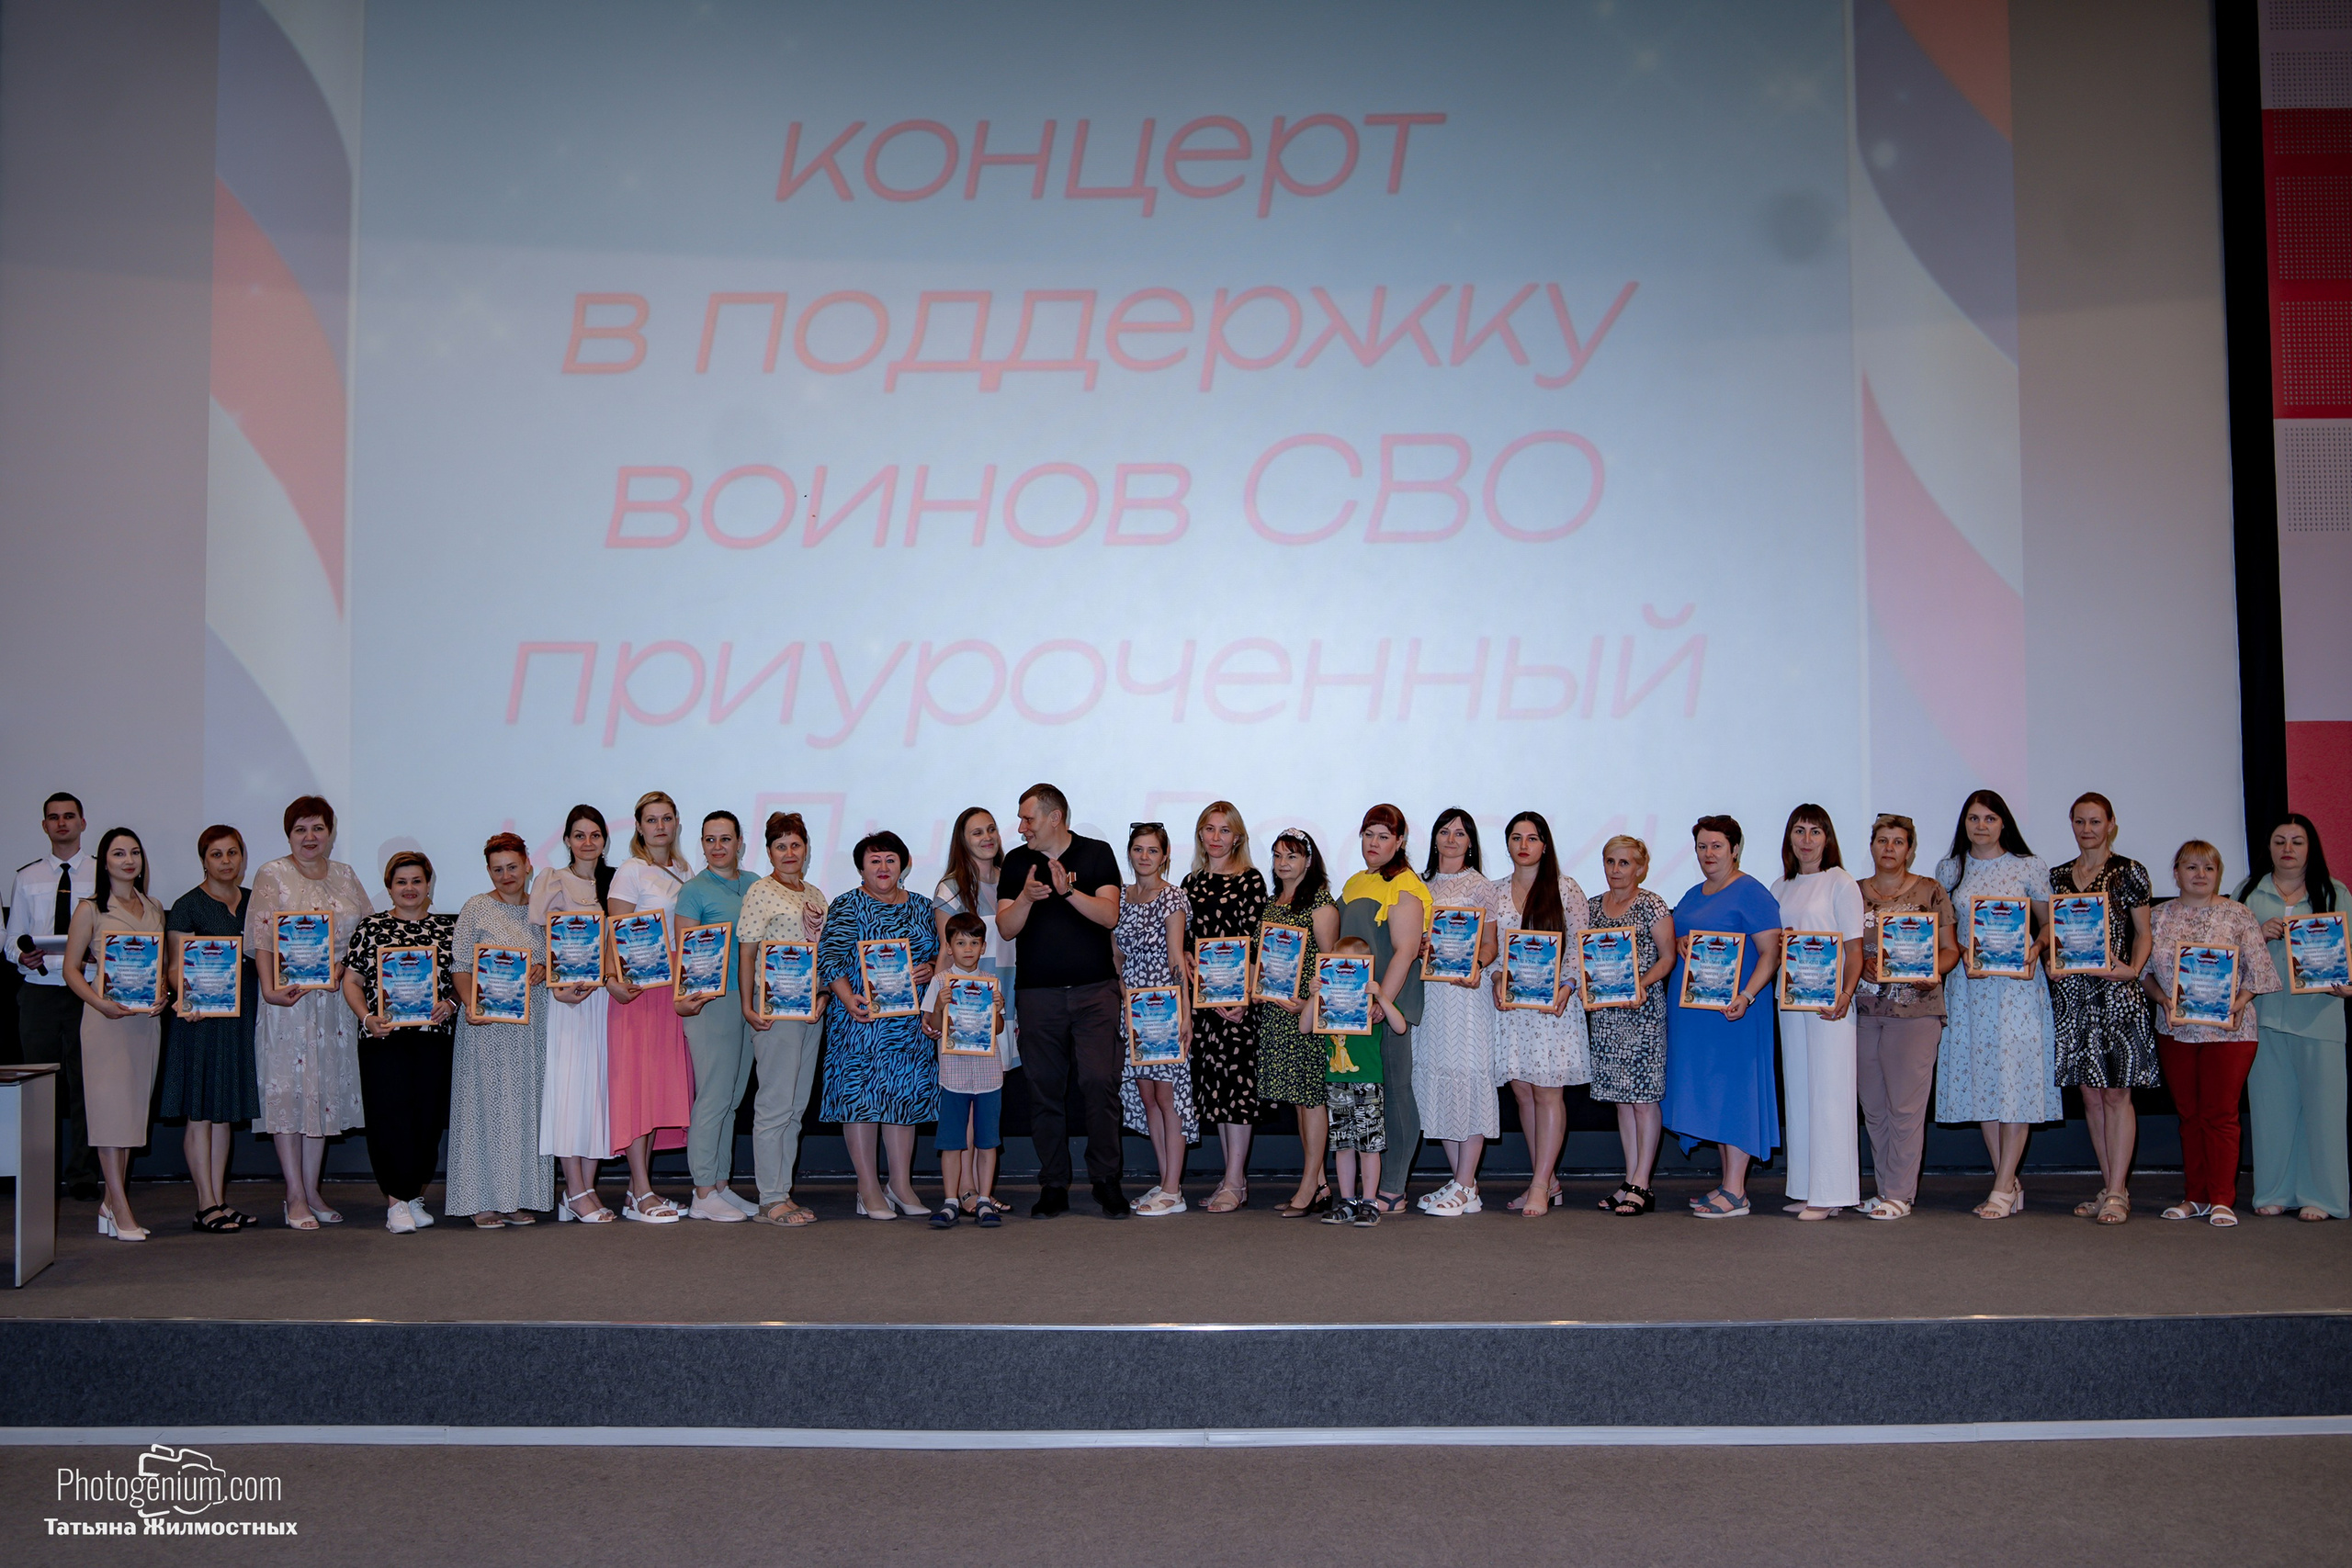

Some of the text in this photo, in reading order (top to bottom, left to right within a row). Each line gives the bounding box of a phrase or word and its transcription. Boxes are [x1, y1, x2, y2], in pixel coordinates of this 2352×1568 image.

[774, 110, 1448, 220] концерт
[560, 279, 1640, 395] в поддержку
[603, 428, 1606, 551] воинов СВО
[503, 603, 1708, 750] приуроченный
